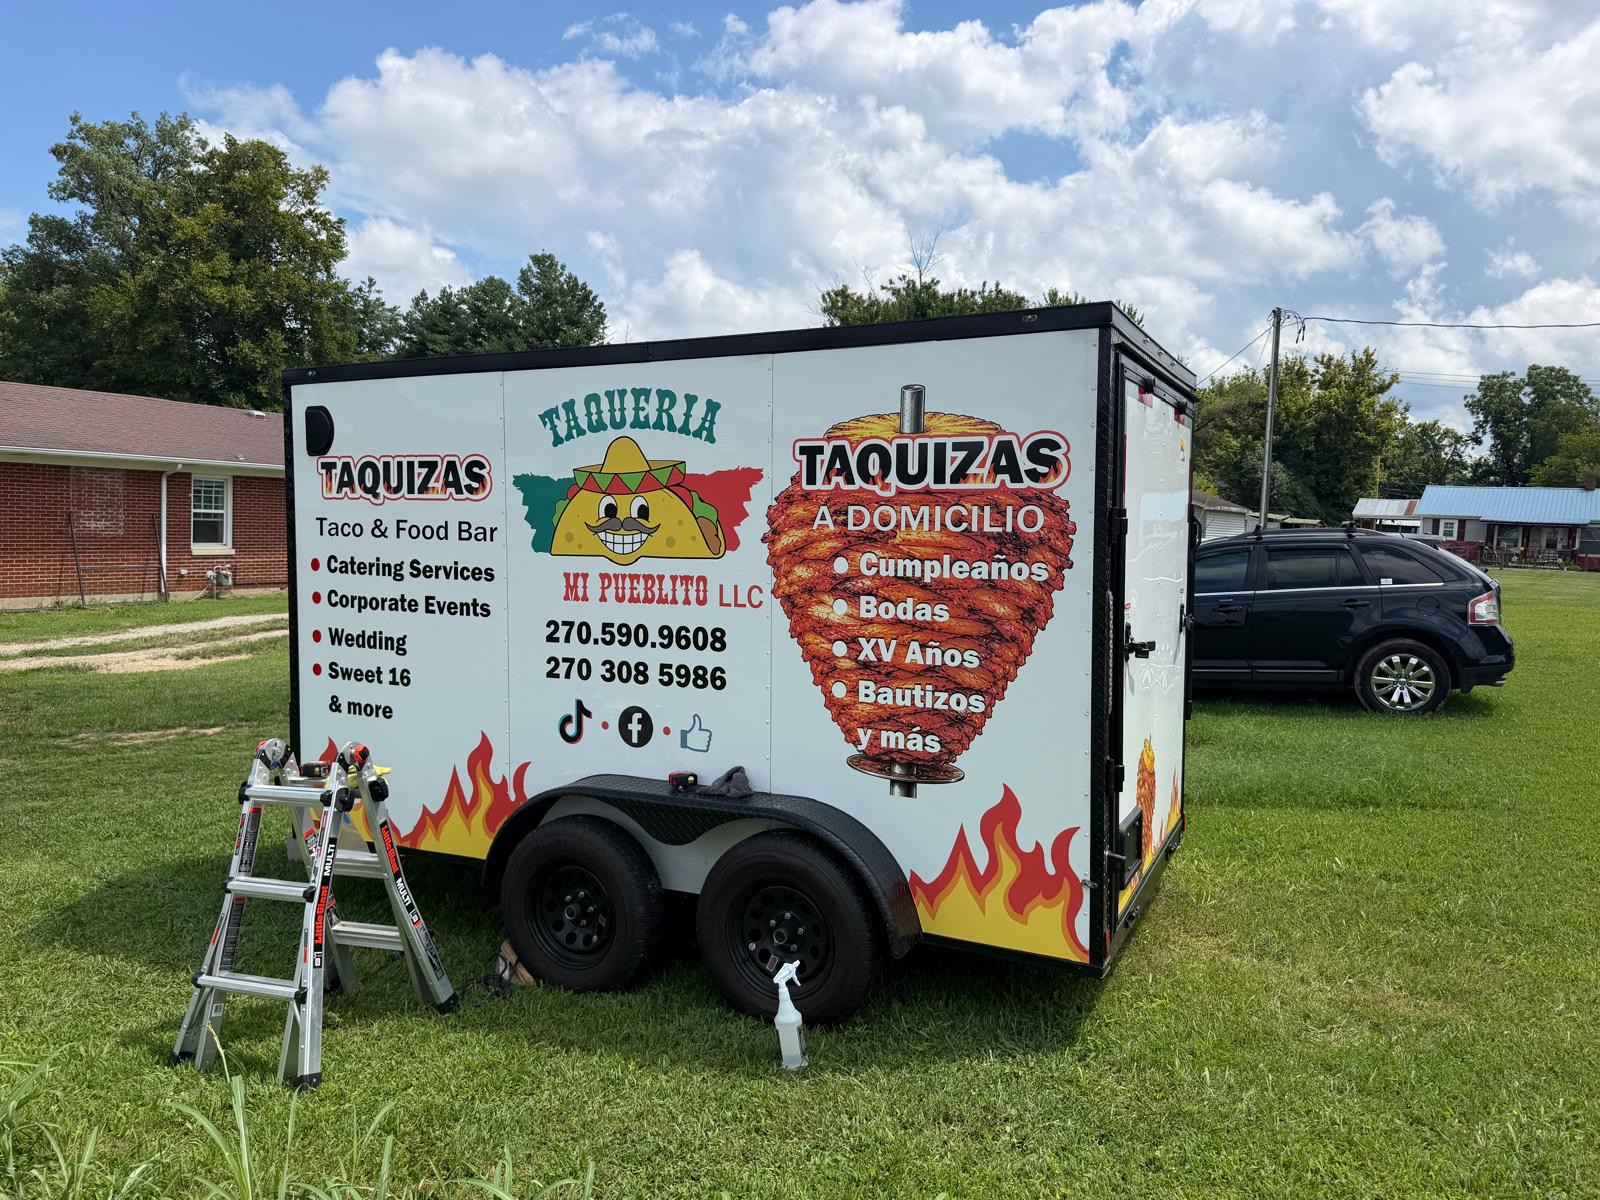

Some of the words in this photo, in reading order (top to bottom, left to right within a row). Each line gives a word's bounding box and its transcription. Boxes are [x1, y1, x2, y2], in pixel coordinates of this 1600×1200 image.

[538, 387, 722, 447] TAQUERIA
[798, 439, 1063, 490] TAQUIZAS
[320, 459, 488, 500] TAQUIZAS
[316, 517, 364, 538] Taco
[371, 519, 388, 539] &
[396, 519, 449, 541] Food
[458, 522, 498, 542] Bar
[813, 505, 835, 530] A
[848, 505, 1044, 533] DOMICILIO
[327, 555, 404, 581] Catering
[409, 560, 495, 582] Services
[859, 552, 1049, 582] Cumpleaños
[327, 590, 419, 616] Corporate
[425, 596, 491, 617] Events
[563, 572, 589, 602] MI
[598, 572, 708, 606] PUEBLITO
[719, 583, 764, 608] LLC
[859, 596, 949, 622] Bodas
[328, 627, 407, 656] Wedding
[546, 620, 726, 652] 270.590.9608
[858, 638, 897, 661] XV
[904, 641, 979, 668] Años
[328, 662, 383, 685] Sweet
[389, 668, 410, 687] 16
[546, 656, 592, 680] 270
[601, 660, 649, 684] 308
[658, 663, 726, 690] 5986
[329, 696, 342, 714] &
[348, 702, 393, 719] more
[858, 681, 986, 713] Bautizos
[857, 728, 872, 751] y
[881, 726, 941, 753] más
[324, 844, 335, 876] MULTI
[396, 877, 410, 906] MULTI
